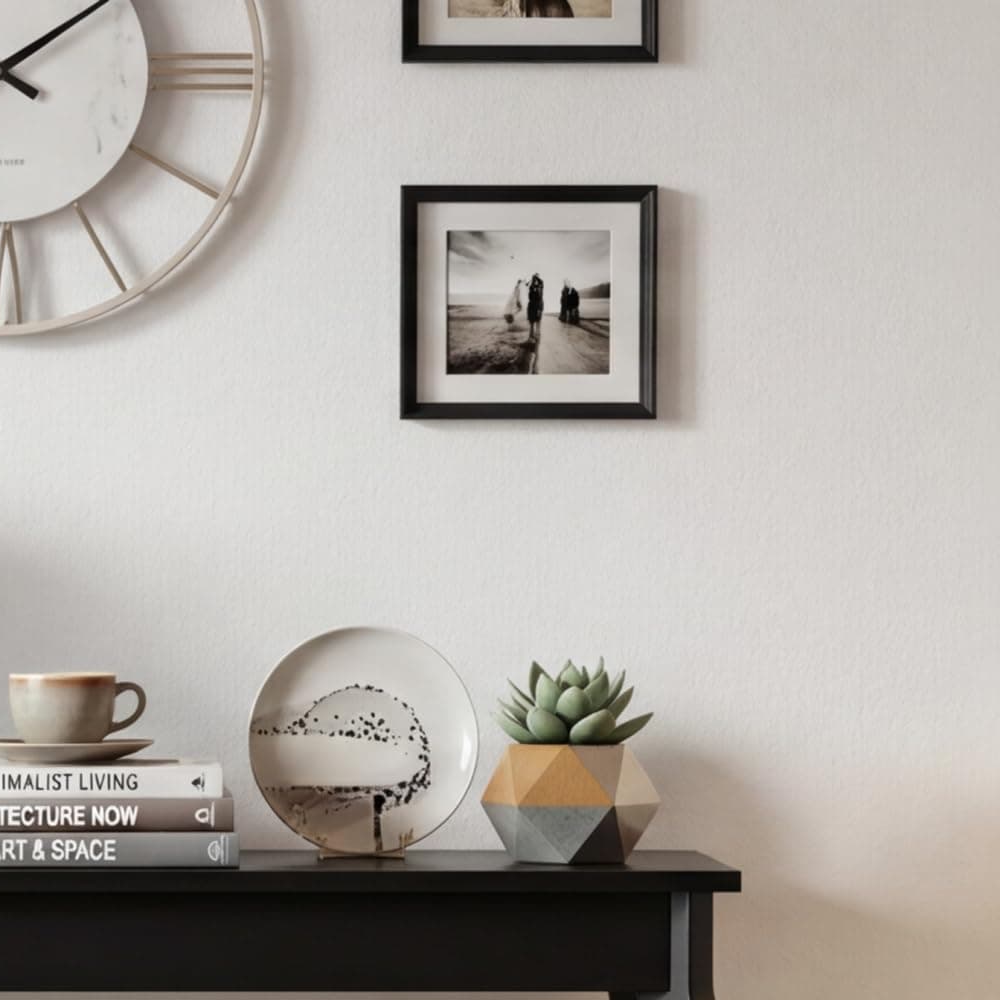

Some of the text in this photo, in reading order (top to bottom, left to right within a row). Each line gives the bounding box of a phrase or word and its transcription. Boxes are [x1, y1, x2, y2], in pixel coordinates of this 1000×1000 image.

[78, 773, 139, 791] LIVING
[91, 805, 139, 826] NOW
[32, 839, 46, 861] &
[51, 840, 117, 861] SPACE
